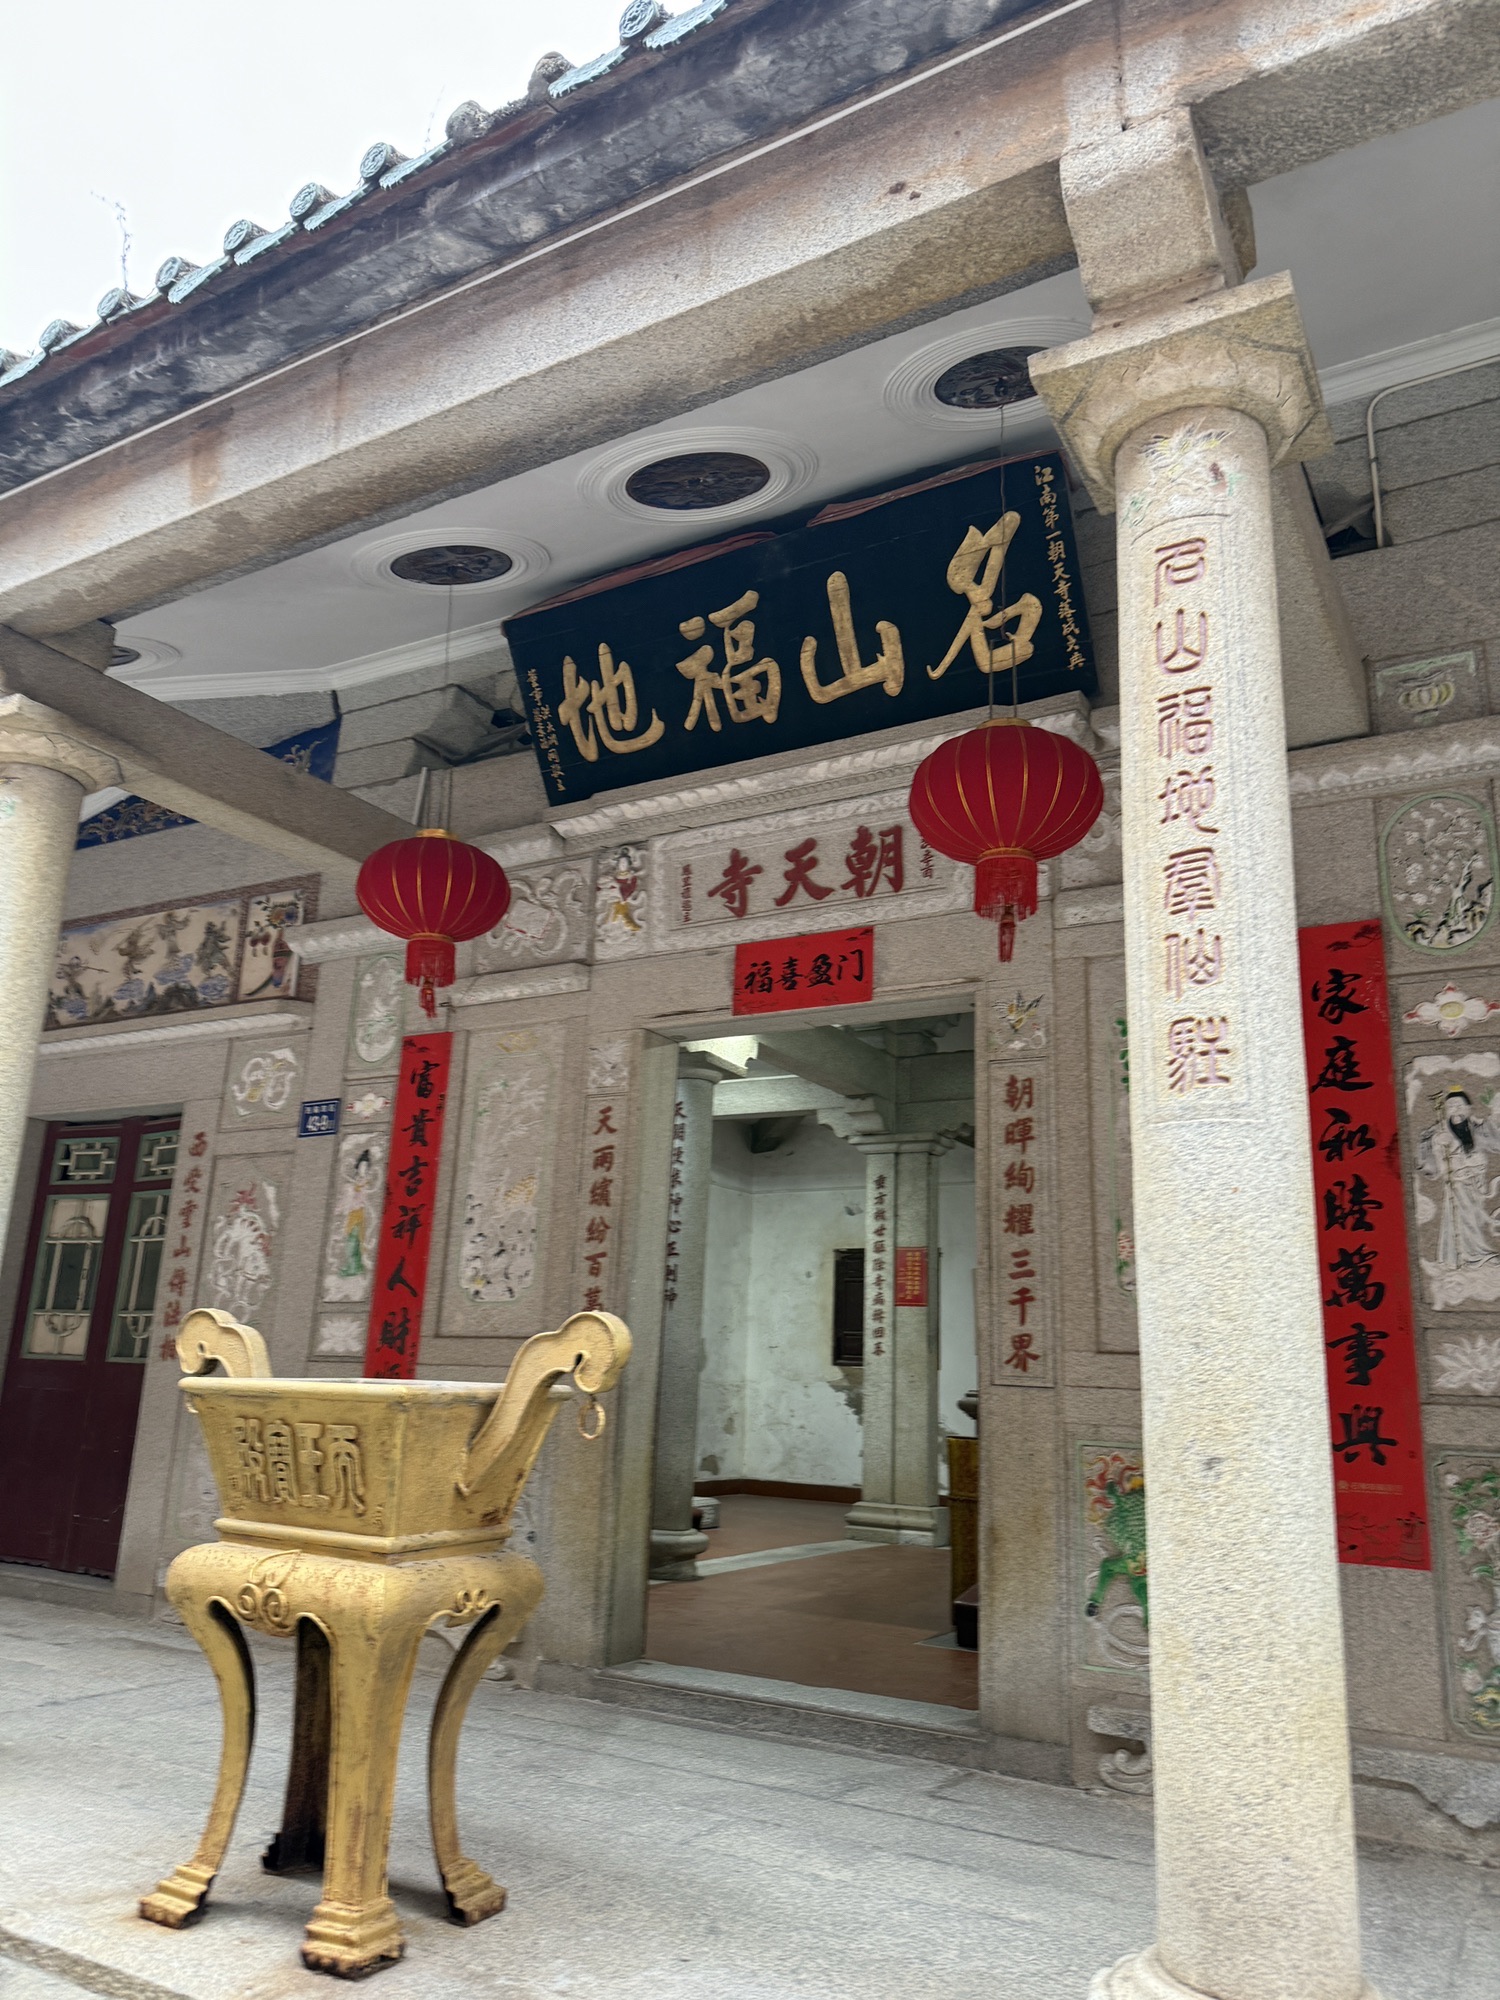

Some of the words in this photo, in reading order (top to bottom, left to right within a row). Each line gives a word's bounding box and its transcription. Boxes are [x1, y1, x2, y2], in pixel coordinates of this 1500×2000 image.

[558, 511, 1043, 763] 名山福地
[707, 825, 905, 918] 朝天寺
[1003, 1074, 1041, 1373] 朝暉絢耀三千界
[1309, 970, 1398, 1467] 家庭和睦萬事興
